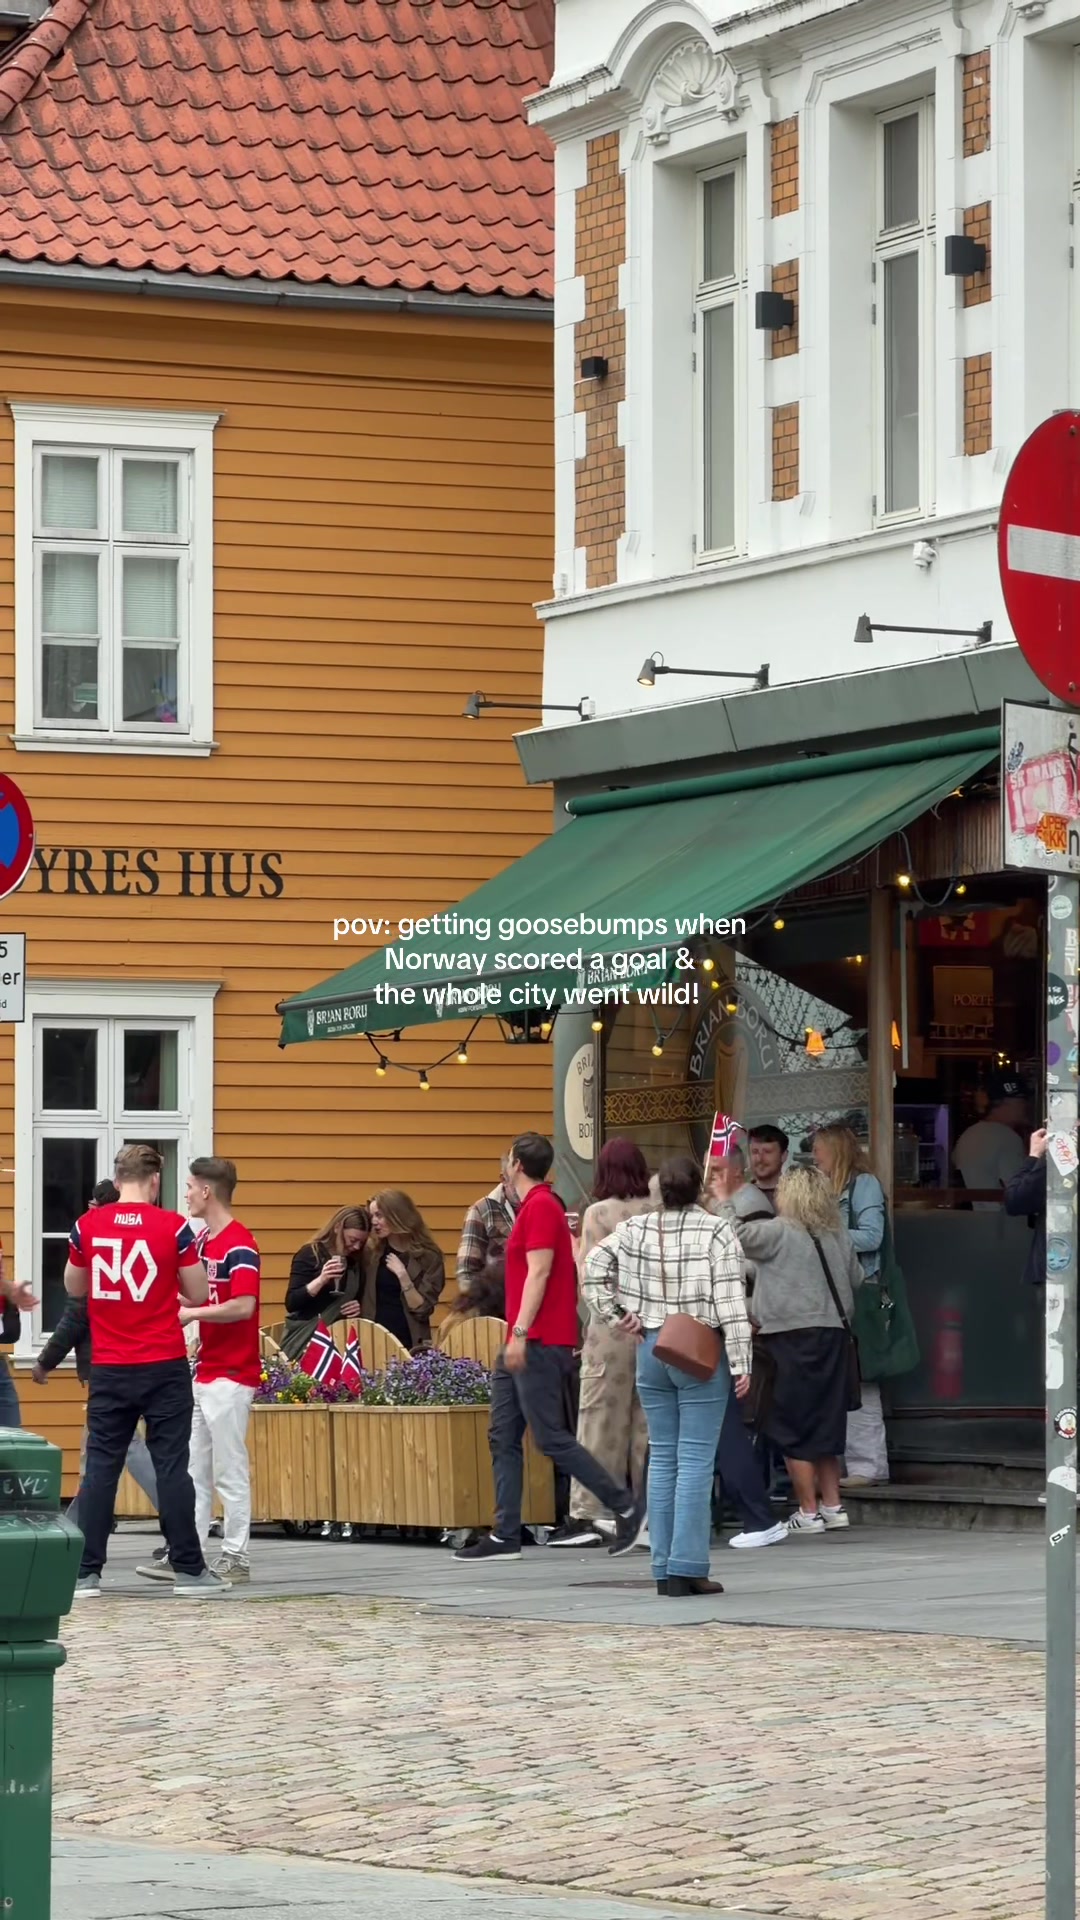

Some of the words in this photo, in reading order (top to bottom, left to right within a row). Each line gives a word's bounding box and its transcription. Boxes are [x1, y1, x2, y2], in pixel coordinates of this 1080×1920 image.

[15, 847, 161, 896] YRES
[177, 850, 285, 898] HUS
[587, 966, 618, 985] BRIAN
[316, 1008, 342, 1025] BRIAN
[343, 1004, 368, 1021] BORU
[690, 994, 730, 1078] BRIAN
[91, 1236, 158, 1303] 20
